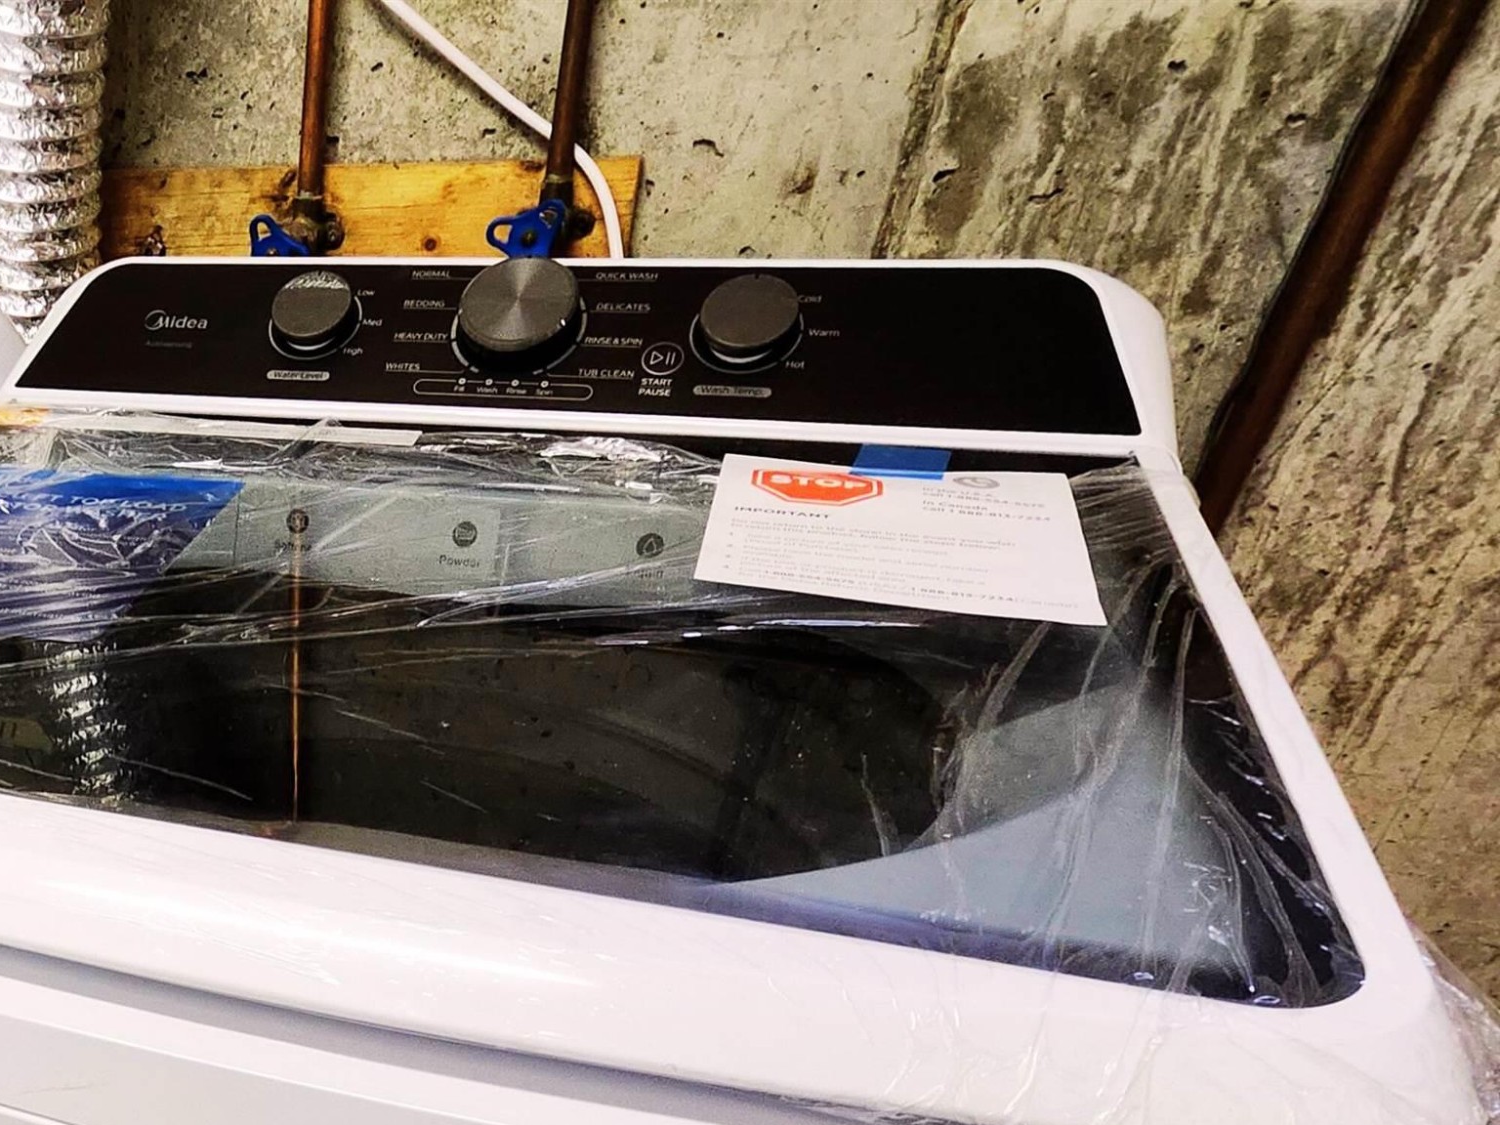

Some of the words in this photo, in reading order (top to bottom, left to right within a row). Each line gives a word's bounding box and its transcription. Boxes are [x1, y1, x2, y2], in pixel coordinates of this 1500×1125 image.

[412, 270, 451, 279] NORMAL
[595, 272, 626, 281] QUICK
[628, 272, 659, 281] WASH
[357, 289, 375, 298] Low
[797, 294, 822, 303] Cold
[403, 299, 446, 308] BEDDING
[595, 303, 651, 312] DELICATES
[144, 309, 209, 331] Midea
[362, 318, 383, 327] Med
[394, 333, 423, 341] HEAVY
[423, 333, 449, 341] DUTY
[808, 328, 841, 337] Warm
[343, 347, 364, 357] High
[385, 362, 421, 371] WHITES
[785, 360, 806, 369] Hot
[273, 371, 300, 380] Water
[301, 371, 324, 380] Level
[578, 369, 599, 378] TUB
[600, 370, 635, 379] CLEAN
[641, 378, 673, 387] START
[453, 385, 466, 393] Fill
[476, 386, 499, 395] Wash
[506, 388, 527, 396] Rinse
[536, 388, 553, 397] Spin
[638, 388, 671, 397] PAUSE
[700, 386, 730, 395] Wash
[769, 474, 868, 489] STOP
[734, 506, 831, 519] IMPORTANT
[438, 554, 481, 568] Powder
